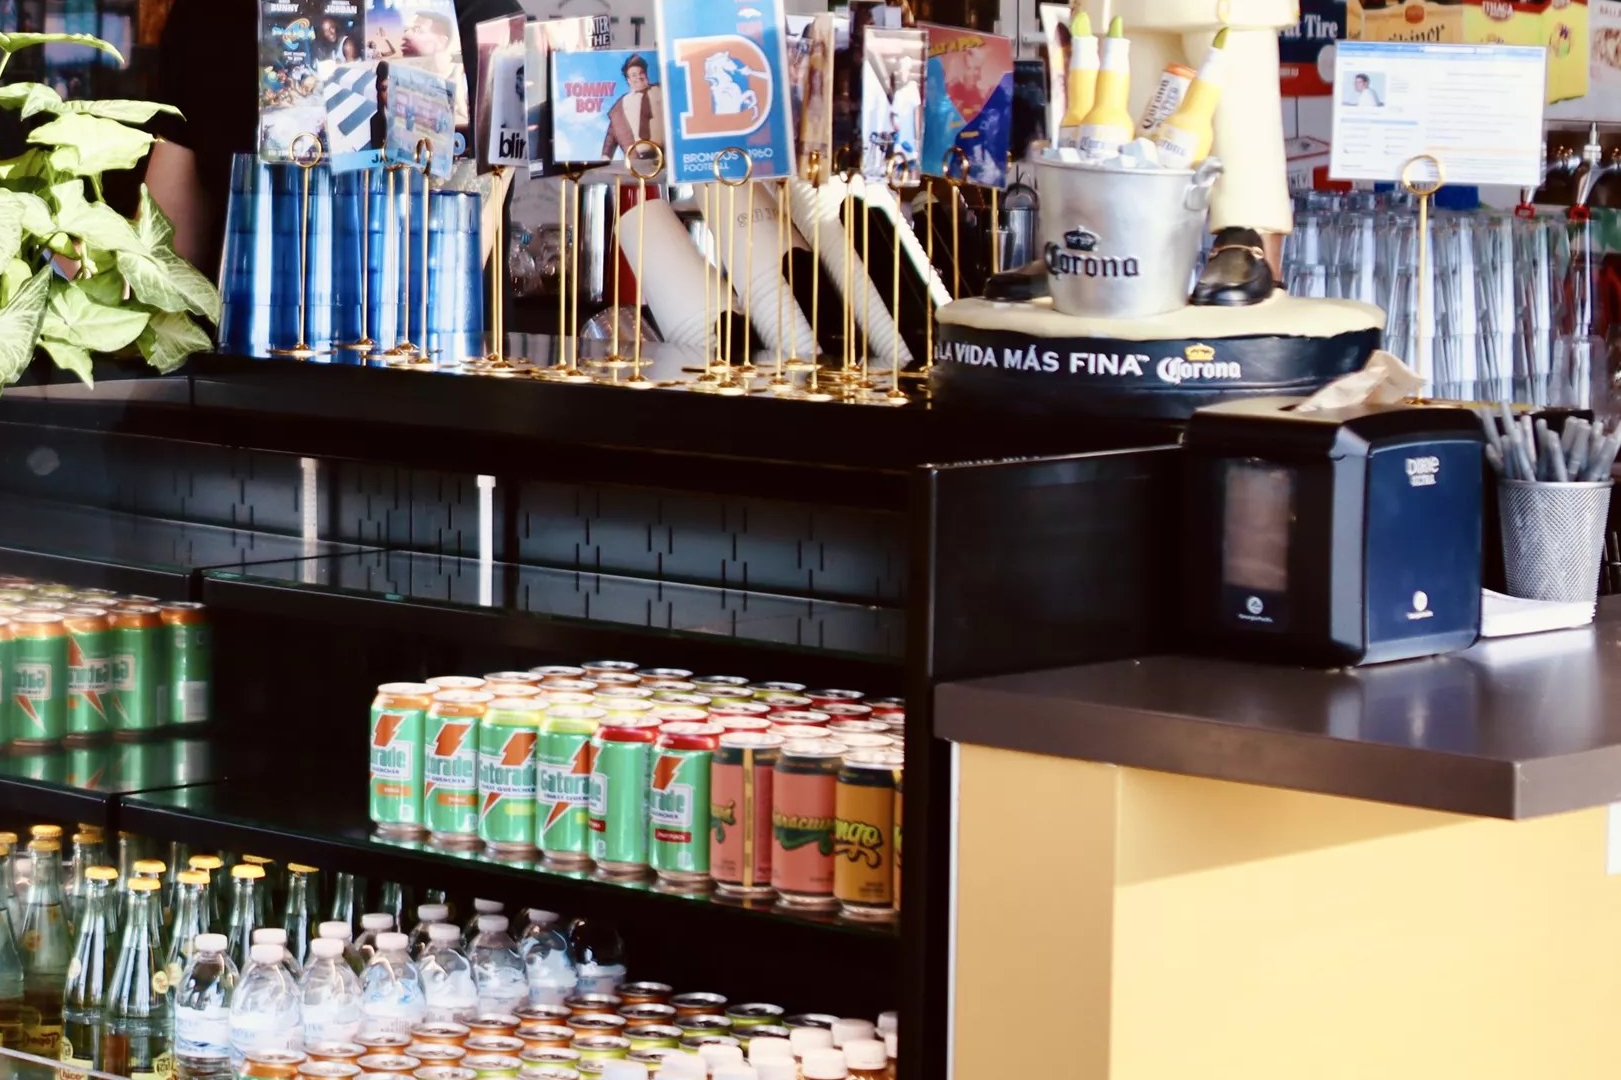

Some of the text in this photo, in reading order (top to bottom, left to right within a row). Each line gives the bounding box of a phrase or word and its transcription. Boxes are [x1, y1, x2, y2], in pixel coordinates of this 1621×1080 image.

[271, 3, 298, 13] BUNNY
[324, 5, 357, 14] JORDAN
[1305, 14, 1338, 38] Tire
[564, 81, 616, 97] TOMMY
[575, 98, 604, 113] BOY
[1044, 241, 1139, 278] Corona
[955, 343, 998, 368] VIDA
[1003, 344, 1060, 373] MÁS
[1156, 357, 1241, 384] Corona
